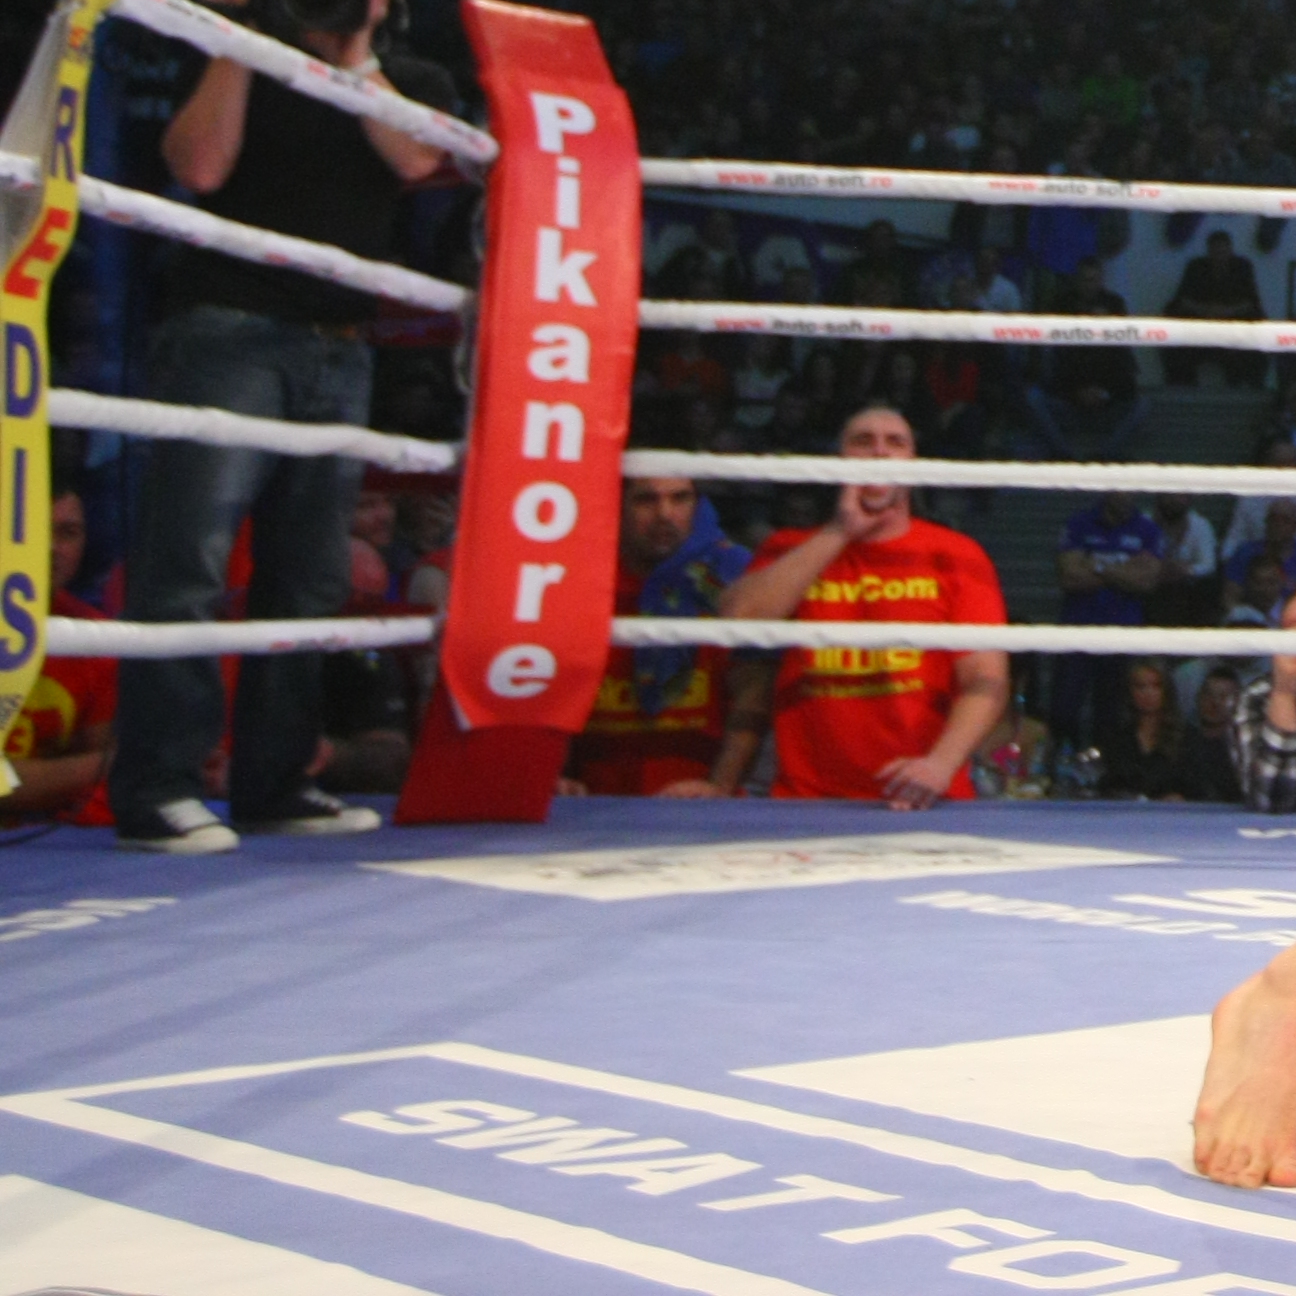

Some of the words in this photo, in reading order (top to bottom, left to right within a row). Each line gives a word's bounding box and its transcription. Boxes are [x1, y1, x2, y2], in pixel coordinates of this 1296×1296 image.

[0, 88, 79, 673] REDIS
[486, 91, 598, 699] Pikanore
[993, 323, 1168, 345] www.auto-soft.ro
[338, 1098, 904, 1214] SWAT
